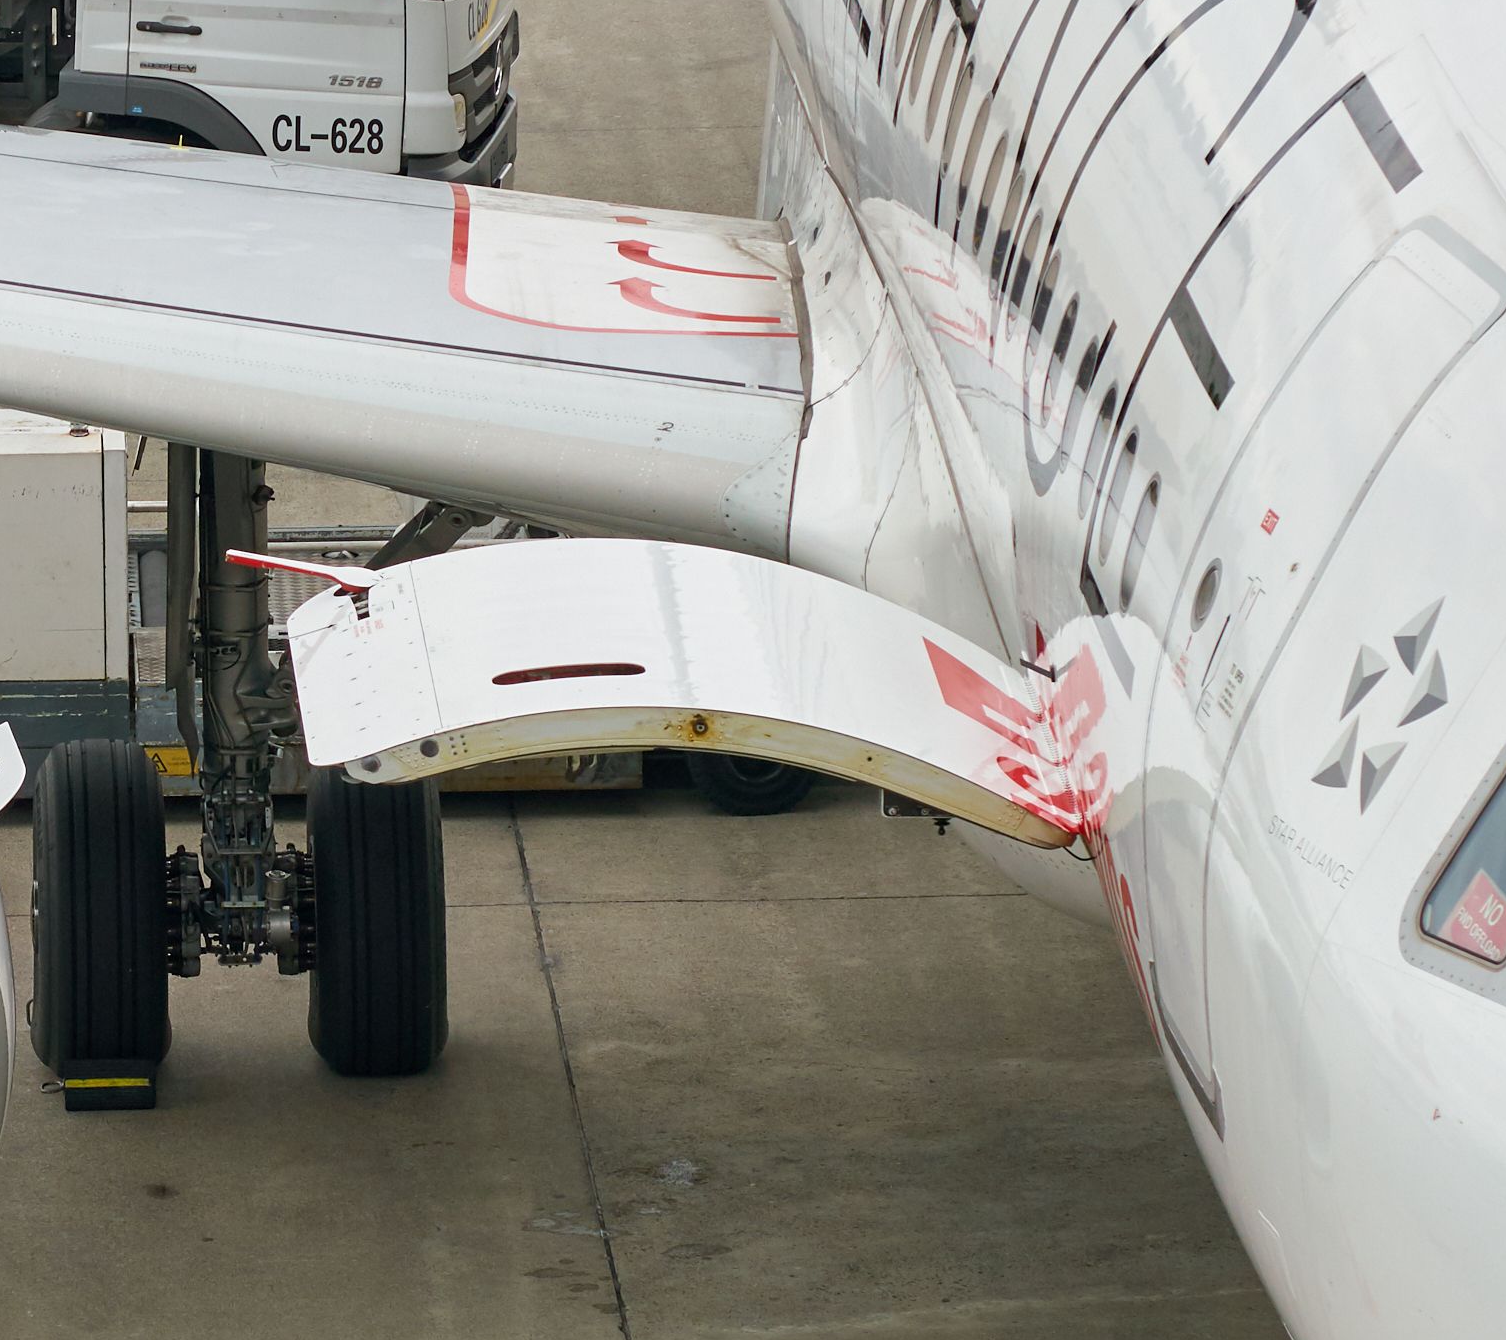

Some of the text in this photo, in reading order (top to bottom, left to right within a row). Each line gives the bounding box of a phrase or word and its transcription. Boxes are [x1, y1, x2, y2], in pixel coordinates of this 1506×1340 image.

[328, 74, 383, 89] 1518
[271, 114, 385, 155] CL-628
[1268, 814, 1354, 890] STAR ALLIANCE
[1479, 893, 1504, 926] NO
